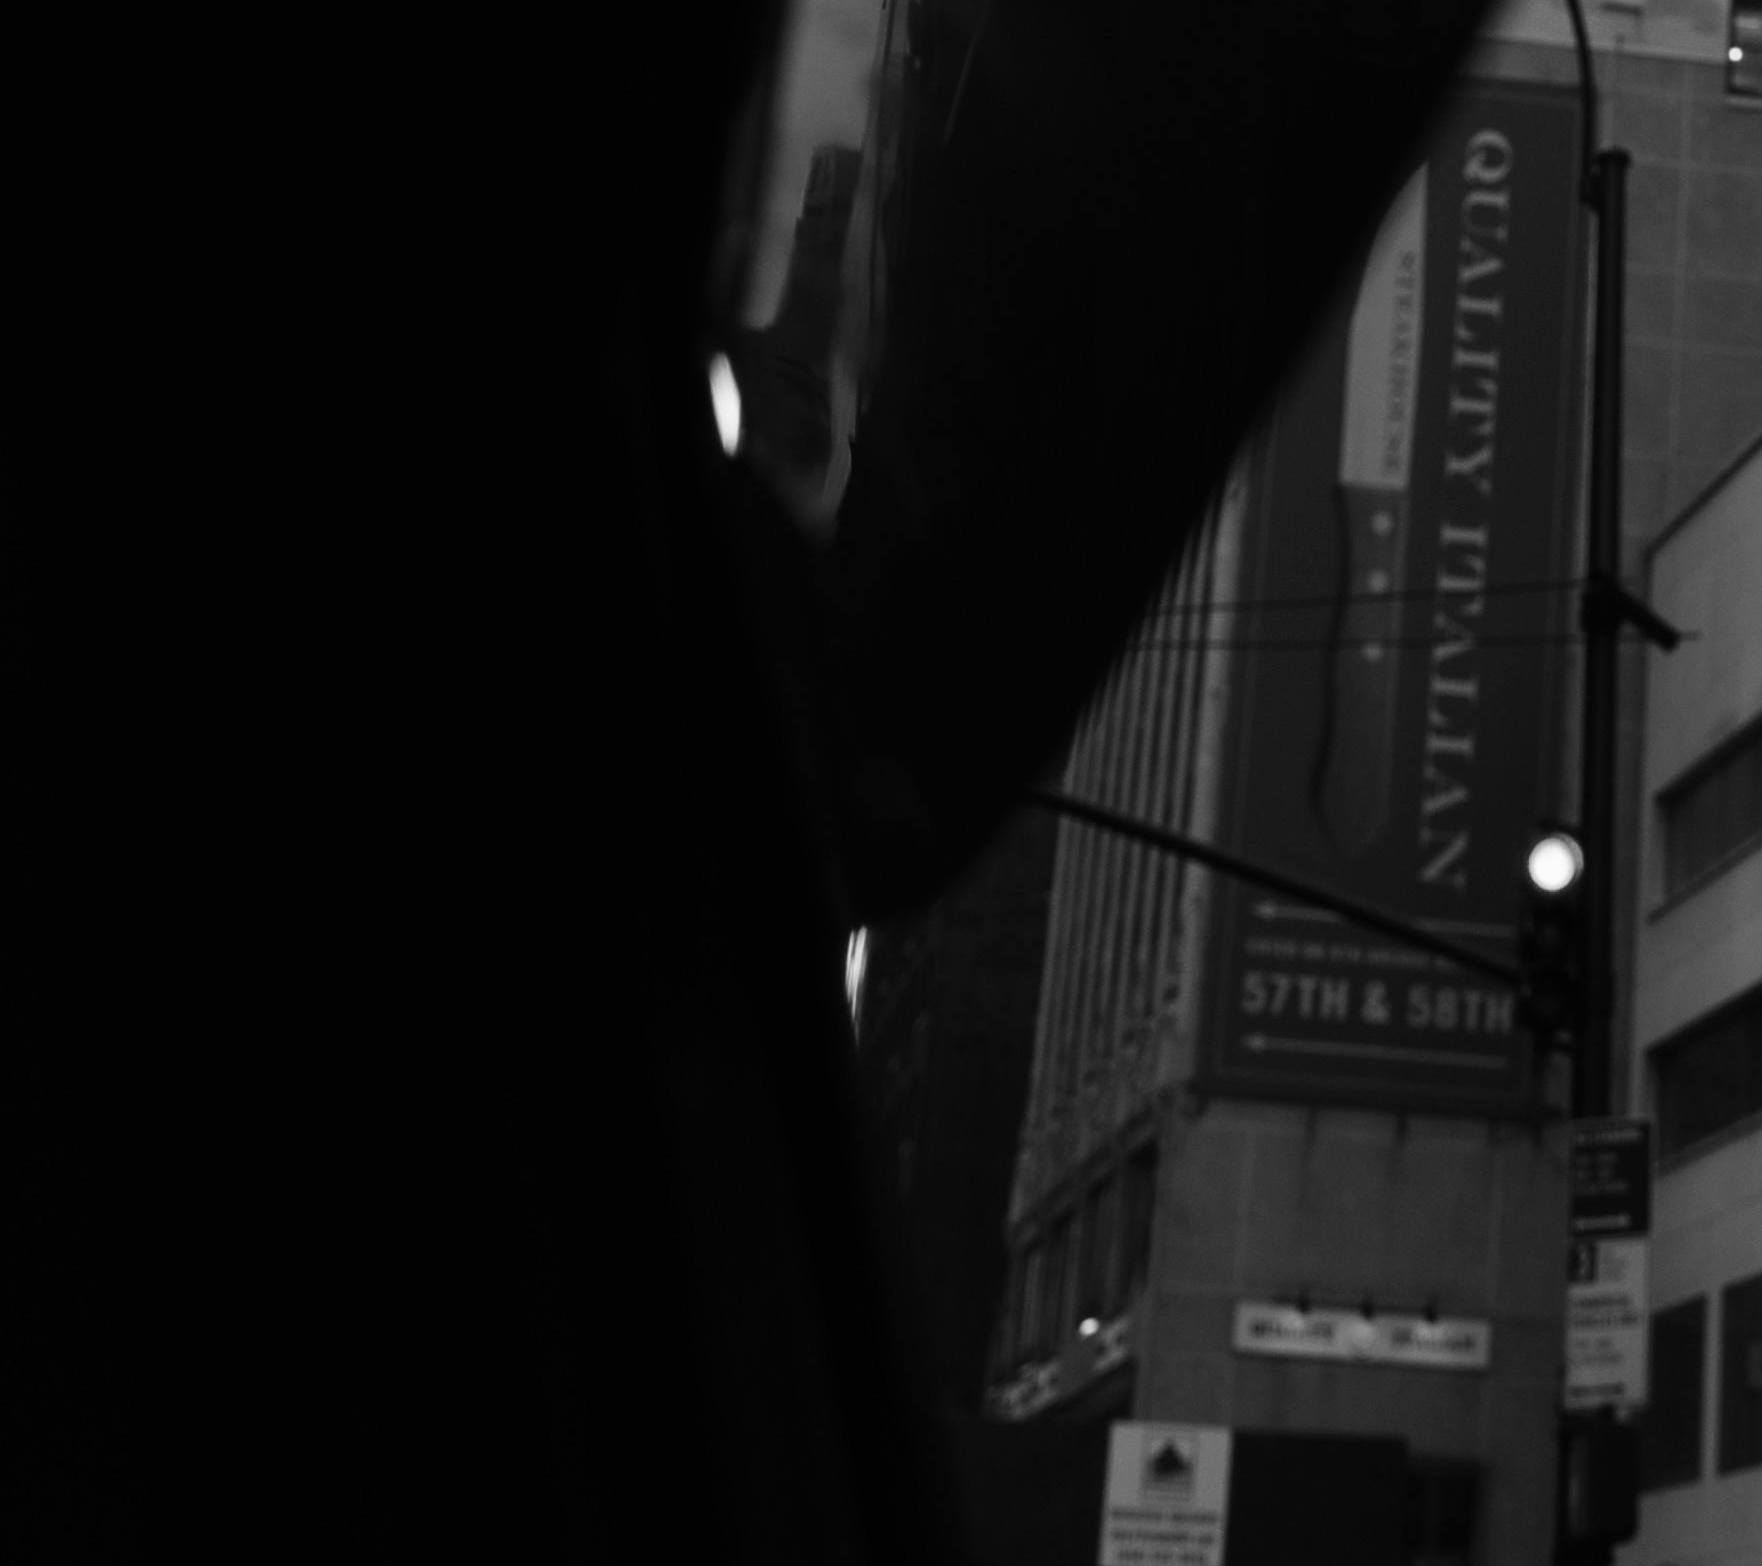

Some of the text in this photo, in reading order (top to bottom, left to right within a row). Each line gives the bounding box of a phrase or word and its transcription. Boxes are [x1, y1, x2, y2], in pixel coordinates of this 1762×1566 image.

[1445, 129, 1514, 496] QUALITY
[1419, 522, 1494, 891] ITALIAN
[1242, 969, 1516, 1036] 57TH & 58TH
